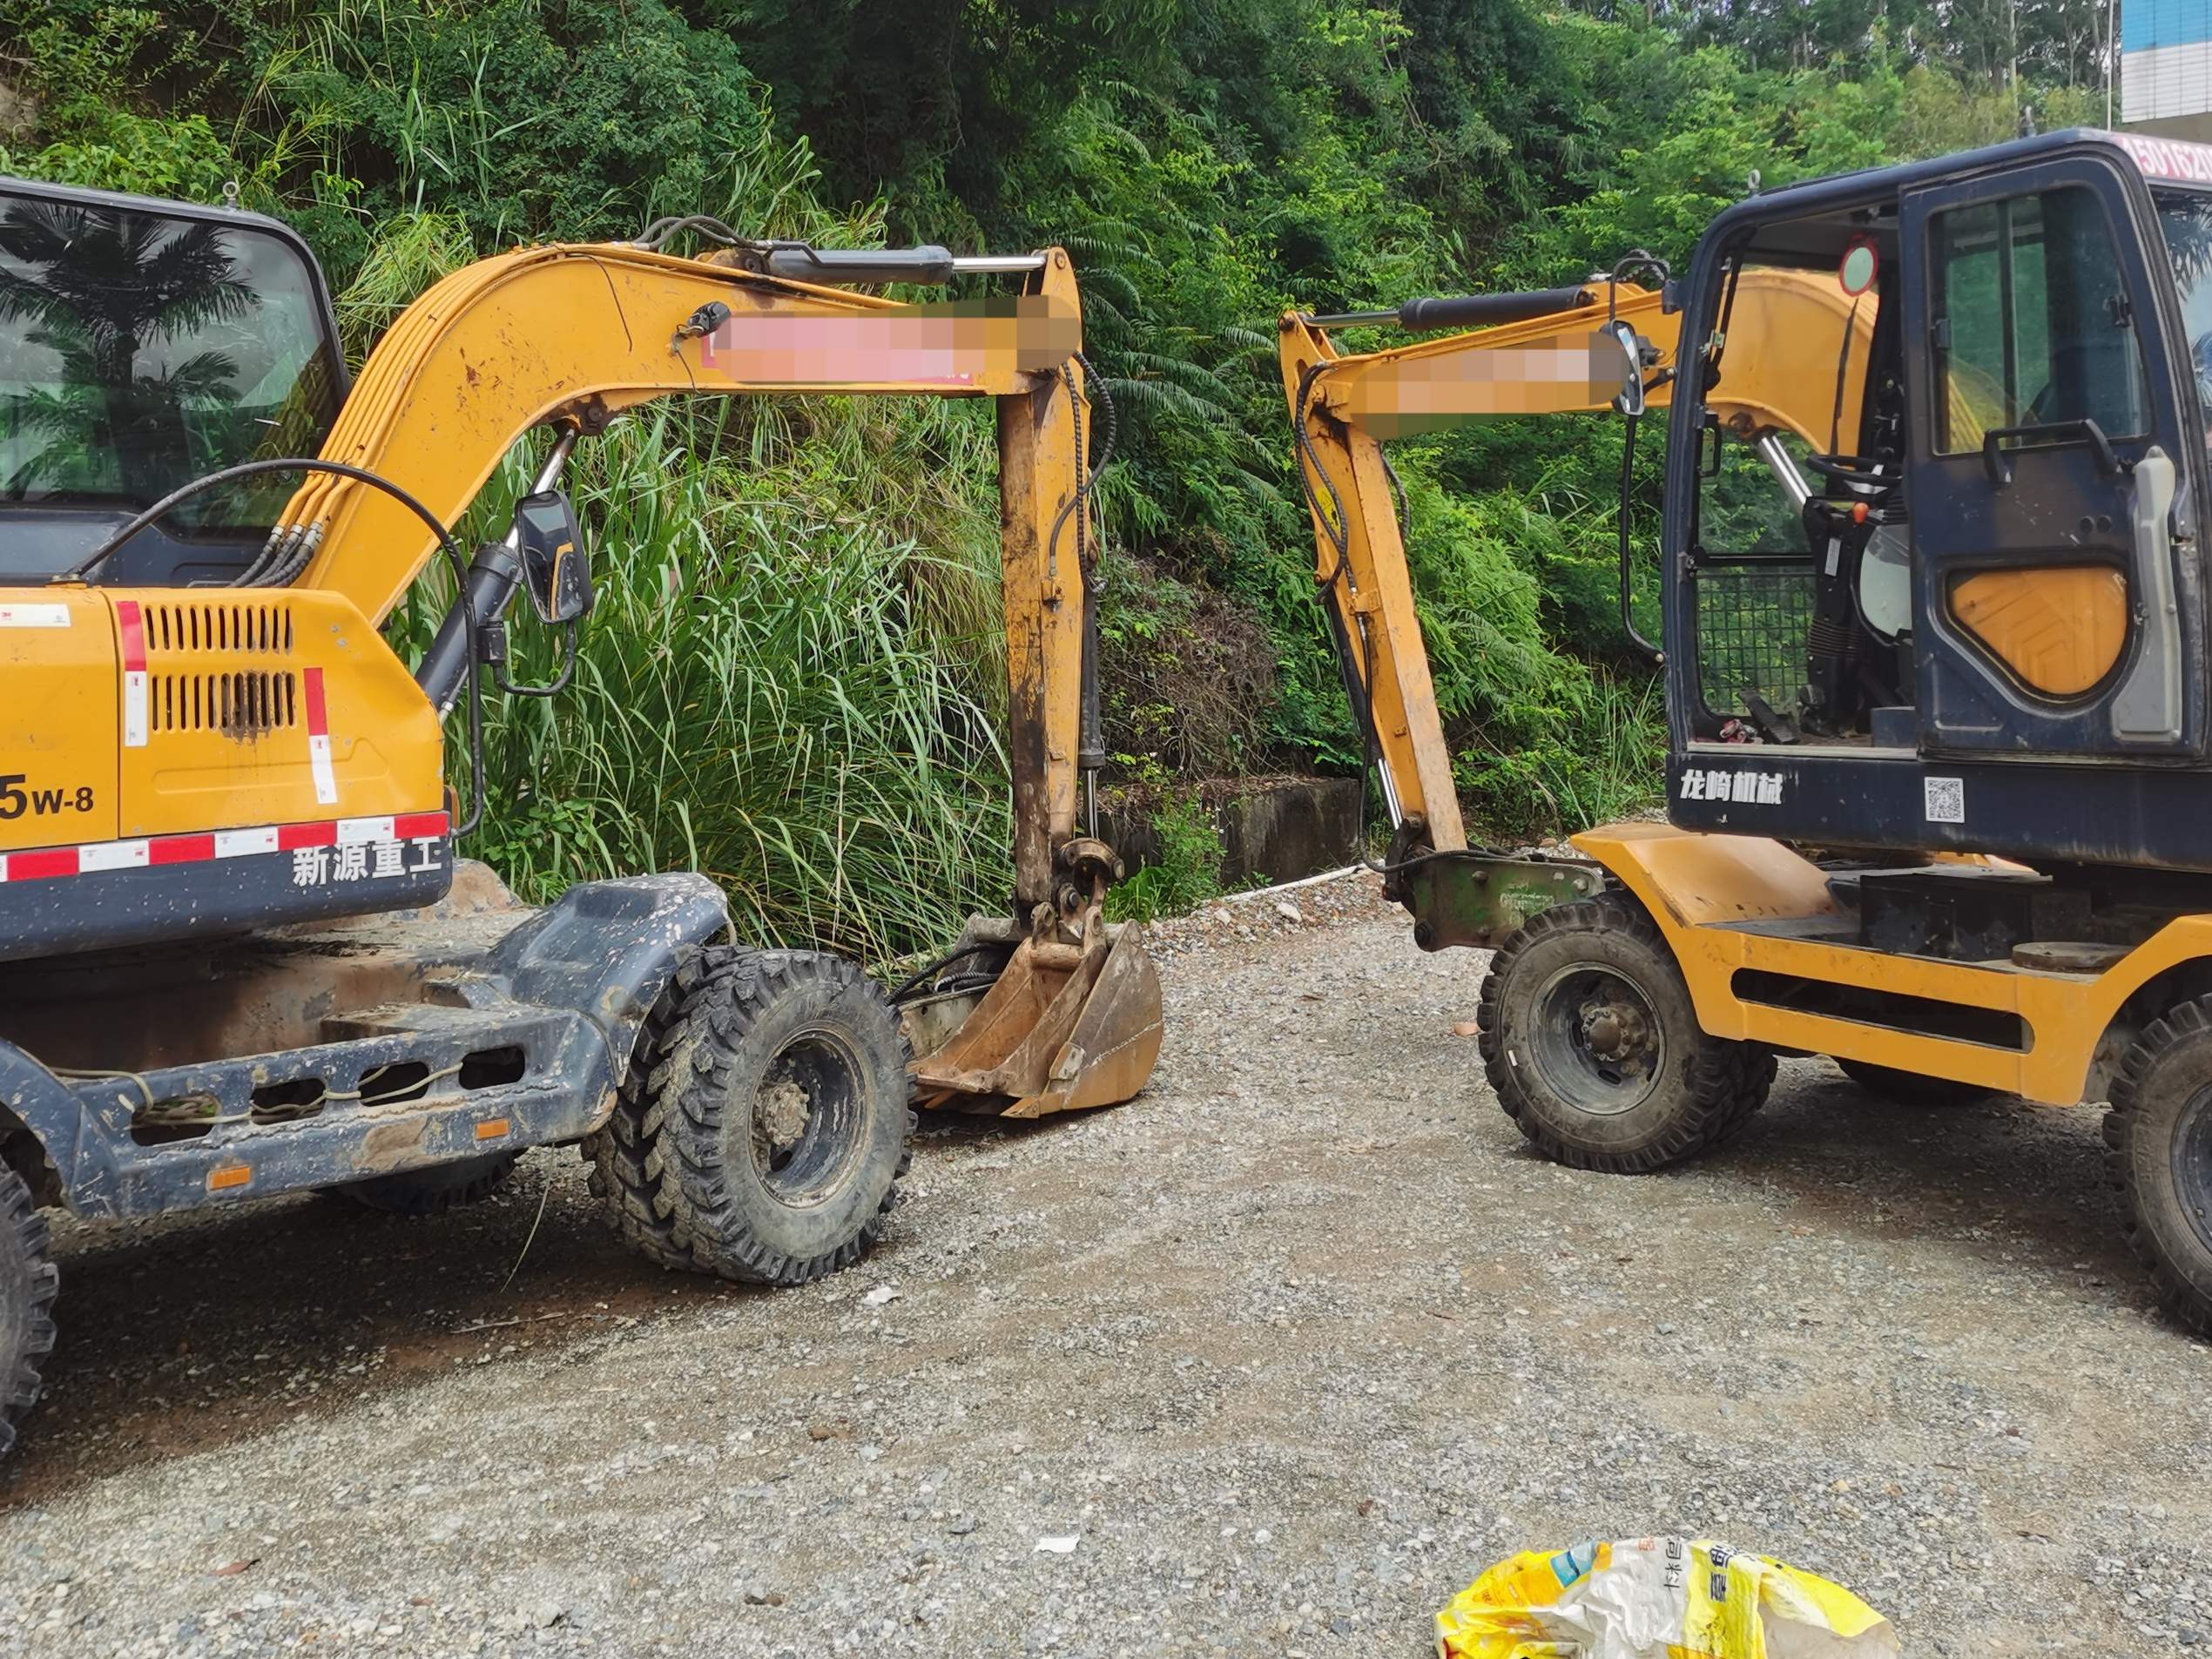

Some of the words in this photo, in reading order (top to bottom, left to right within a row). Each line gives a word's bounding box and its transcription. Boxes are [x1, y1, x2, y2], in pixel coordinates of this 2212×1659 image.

[2122, 138, 2212, 180] 1501620
[1680, 769, 1784, 805] 龙崎机械
[293, 836, 442, 887] 新源重工
